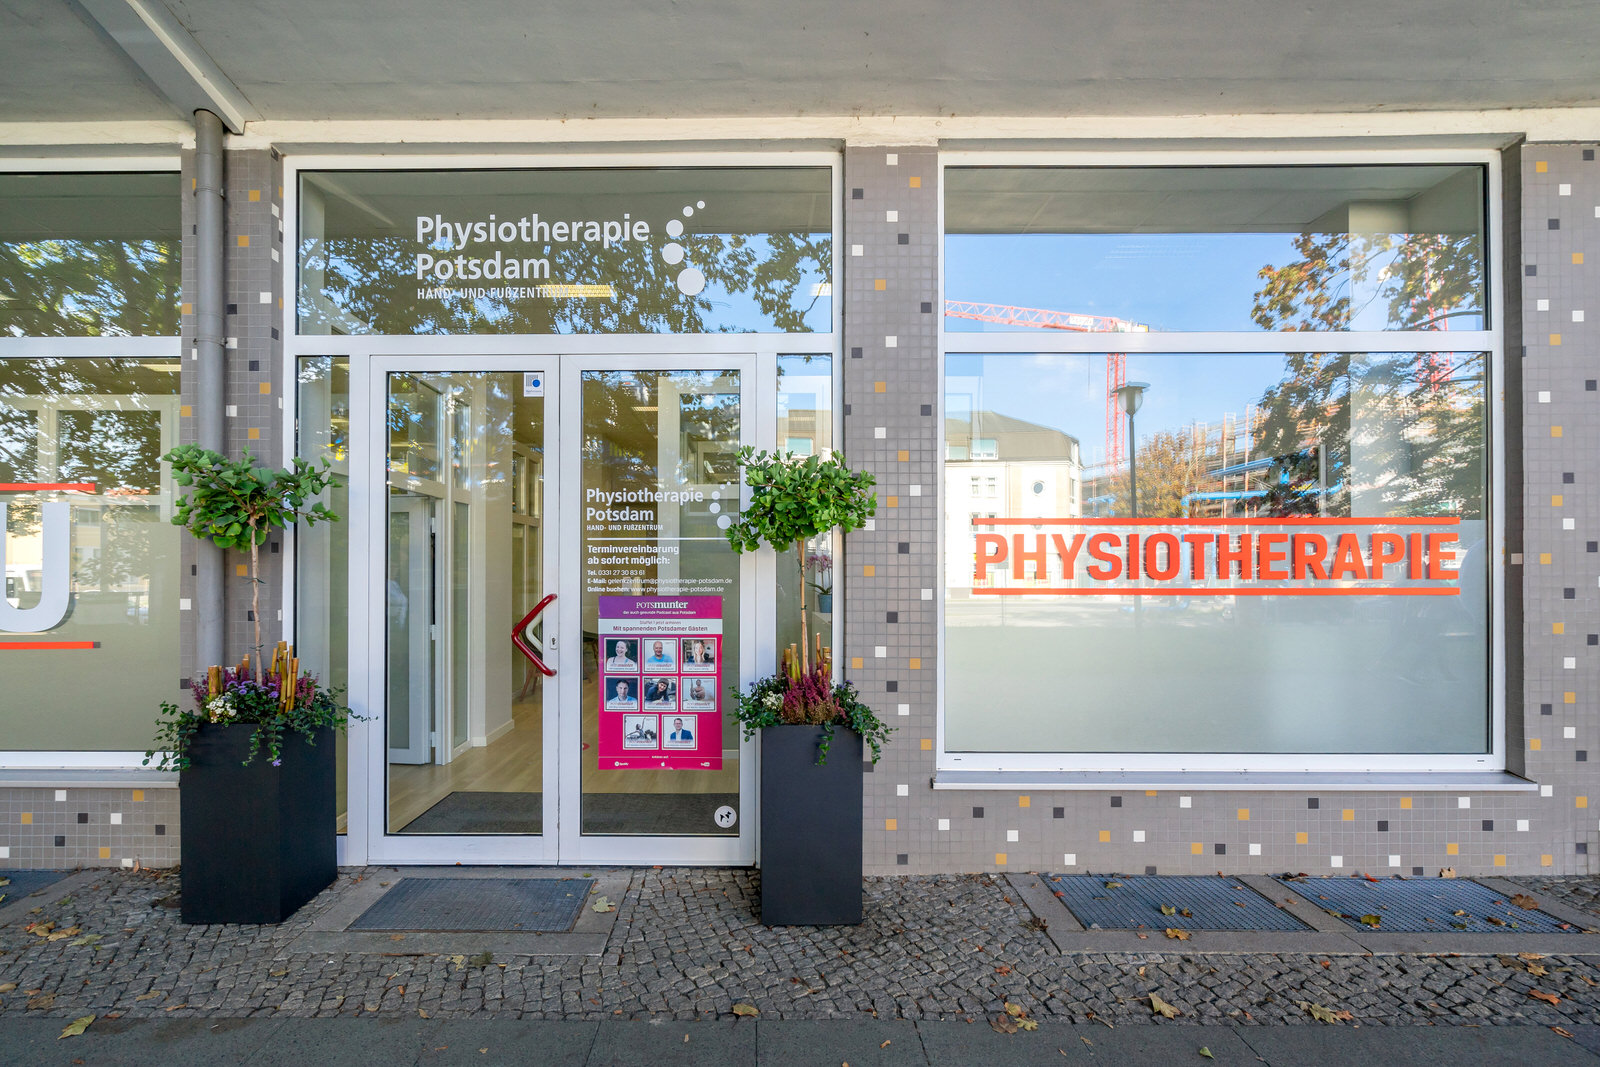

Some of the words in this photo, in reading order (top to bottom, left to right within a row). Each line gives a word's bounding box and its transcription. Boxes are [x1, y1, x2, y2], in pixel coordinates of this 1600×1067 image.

[416, 213, 650, 250] Physiotherapie
[416, 251, 550, 280] Potsdam
[417, 288, 456, 300] HAND-
[460, 288, 486, 299] UND
[490, 286, 569, 298] FUßZENTRUM
[586, 488, 704, 506] Physiotherapie
[586, 506, 654, 522] Potsdam
[587, 545, 679, 555] Terminvereinbarung
[976, 532, 1459, 581] PHYSIOTHERAPIE
[587, 556, 599, 564] ab
[601, 556, 629, 564] sofort
[630, 556, 670, 566] möglich:
[636, 600, 688, 609] POTSmunter
